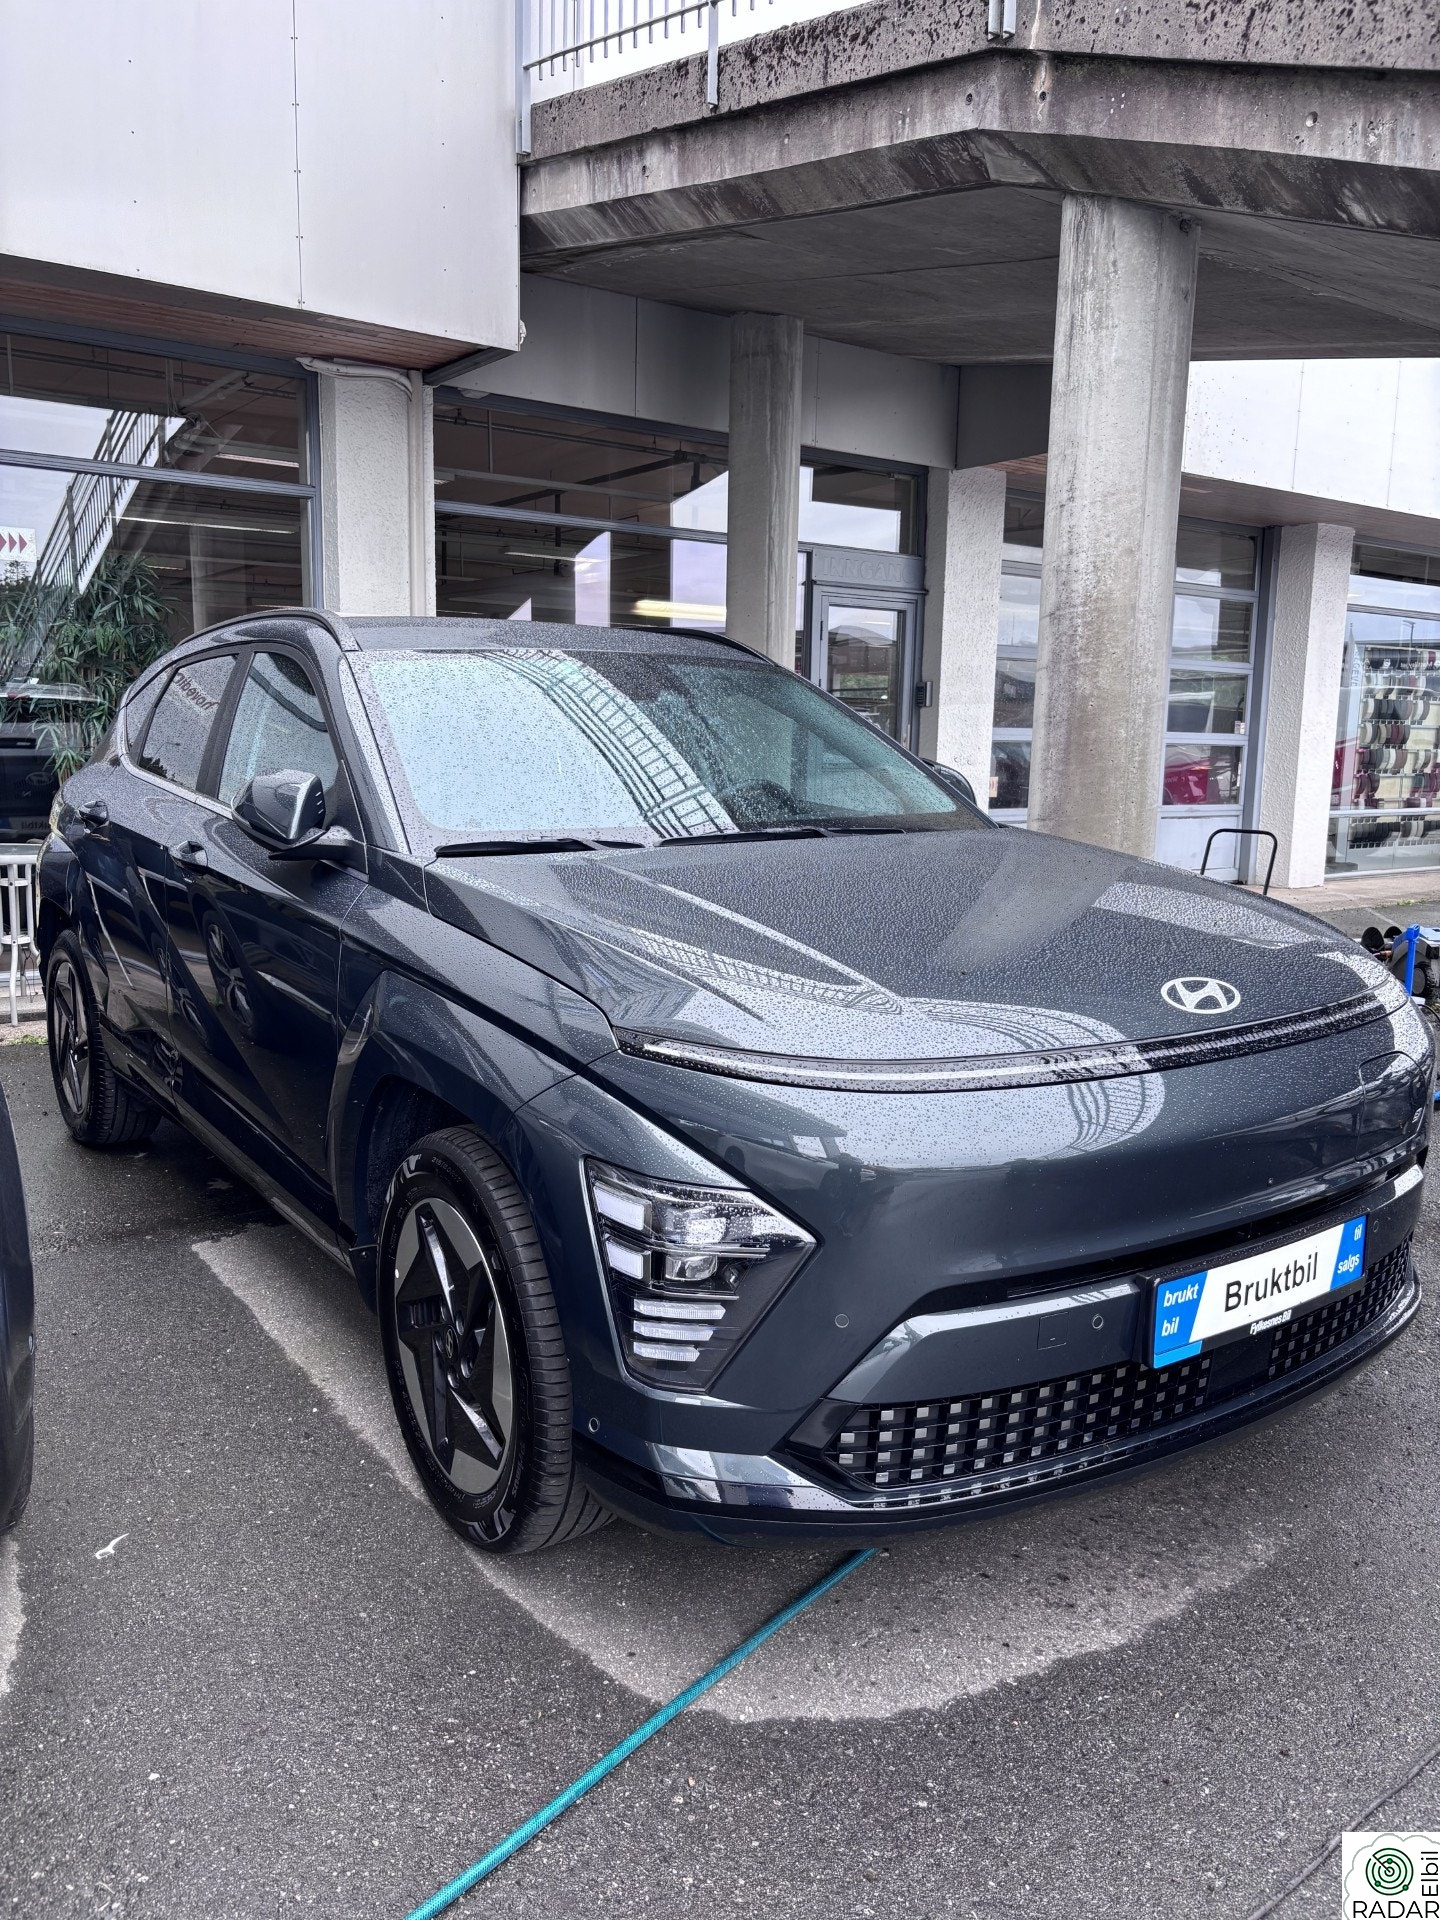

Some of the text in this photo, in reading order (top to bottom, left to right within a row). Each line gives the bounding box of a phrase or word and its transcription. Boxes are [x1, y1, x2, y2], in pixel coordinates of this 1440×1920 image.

[1354, 1223, 1363, 1241] til
[1337, 1253, 1360, 1274] salgs
[1224, 1252, 1318, 1312] Bruktbil
[1163, 1282, 1199, 1307] brukt
[1161, 1317, 1180, 1336] bil
